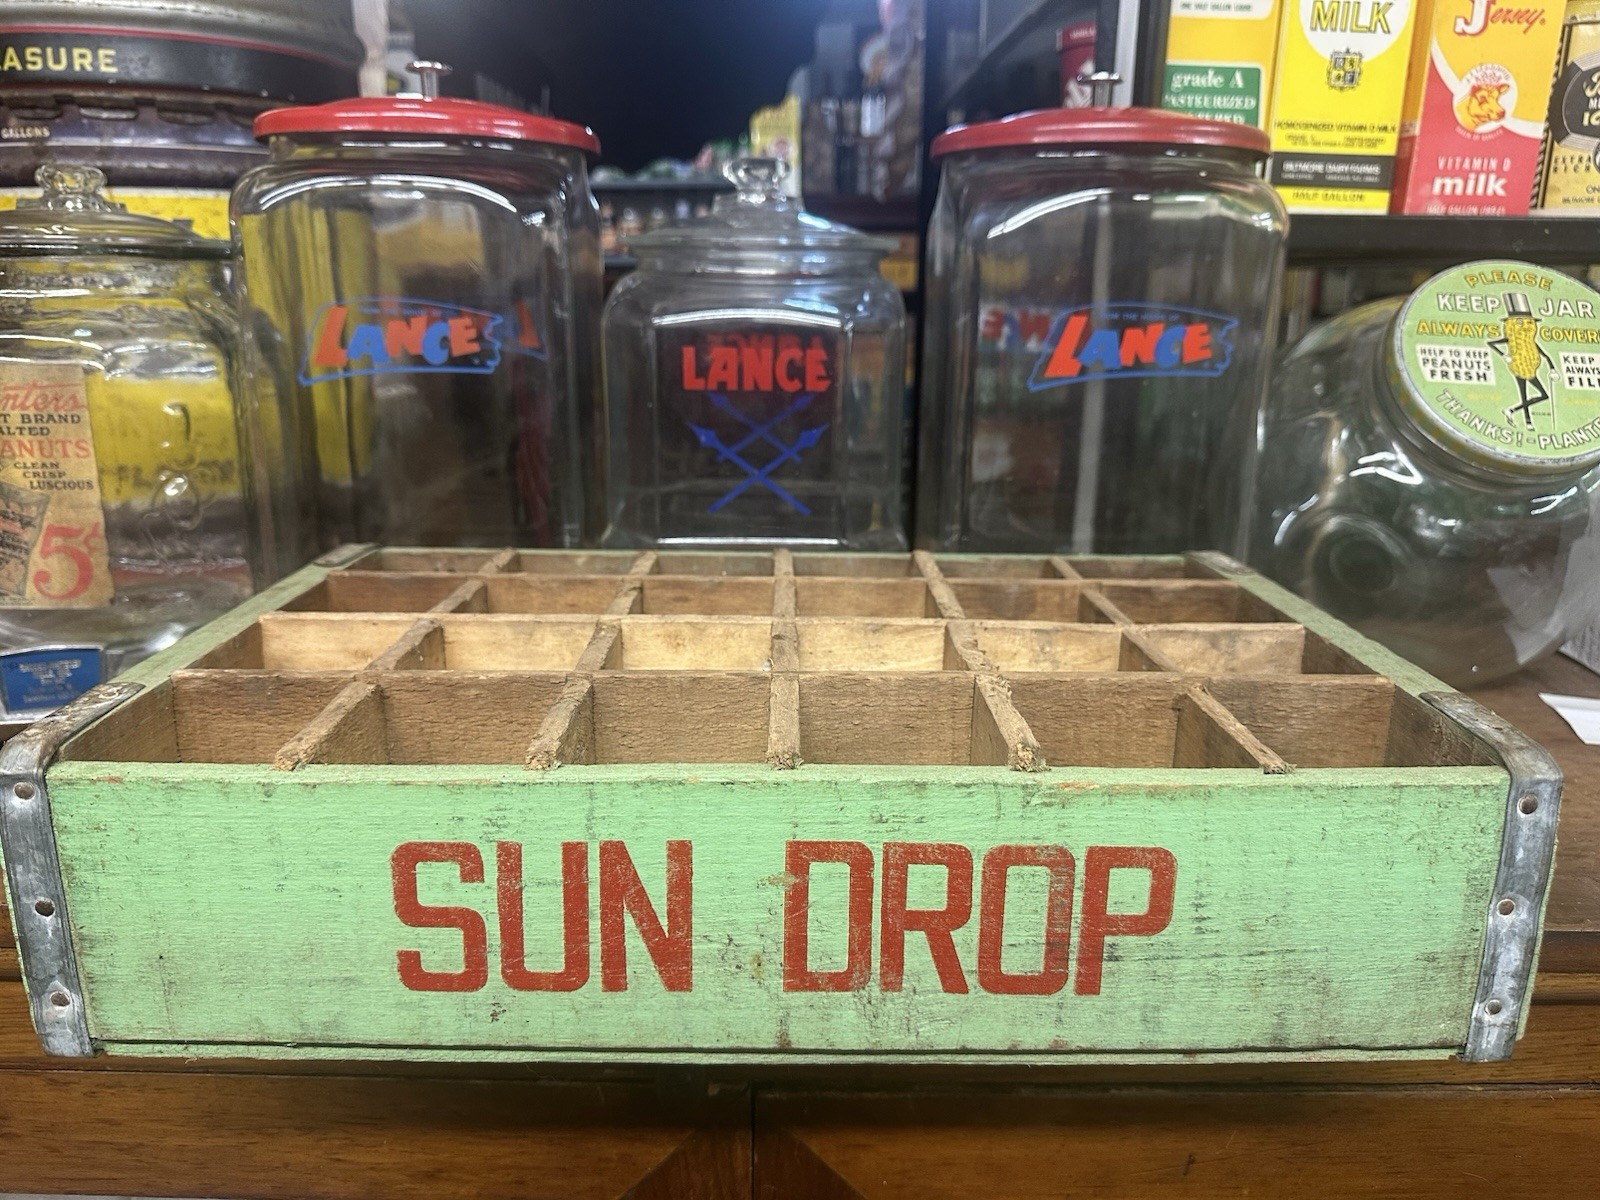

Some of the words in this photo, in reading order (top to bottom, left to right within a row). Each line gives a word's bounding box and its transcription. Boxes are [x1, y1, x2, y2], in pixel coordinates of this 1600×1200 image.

[1310, 0, 1393, 34] MILK
[0, 46, 119, 73] ASURE
[1171, 69, 1225, 92] grade
[1229, 69, 1244, 88] A
[1438, 156, 1497, 171] VITAMIN
[1503, 157, 1512, 172] D
[1553, 163, 1591, 173] RICH
[1554, 154, 1591, 164] EXTRA
[1432, 173, 1508, 197] milk
[1464, 270, 1553, 291] PLEASE
[1437, 293, 1500, 313] KEEP
[1539, 298, 1595, 318] JAR
[313, 305, 480, 367] LANCE
[1417, 319, 1500, 338] ALWAYS
[1540, 325, 1600, 344] COVER
[1043, 314, 1213, 378] LANCE
[1421, 347, 1444, 356] HELP
[1449, 349, 1460, 358] TO
[1466, 350, 1488, 359] KEEP
[681, 345, 832, 392] LANCE
[1422, 358, 1491, 371] PEANUTS
[1563, 355, 1595, 364] KEEP
[1430, 370, 1488, 382] FRESH
[21, 413, 81, 424] BRAND
[1436, 388, 1523, 447] THANKS!
[14, 461, 60, 469] CLEAN
[23, 471, 66, 479] CRISP
[30, 480, 94, 490] LUSCIOUS
[391, 839, 693, 993] SUN
[783, 841, 1179, 996] DROP
